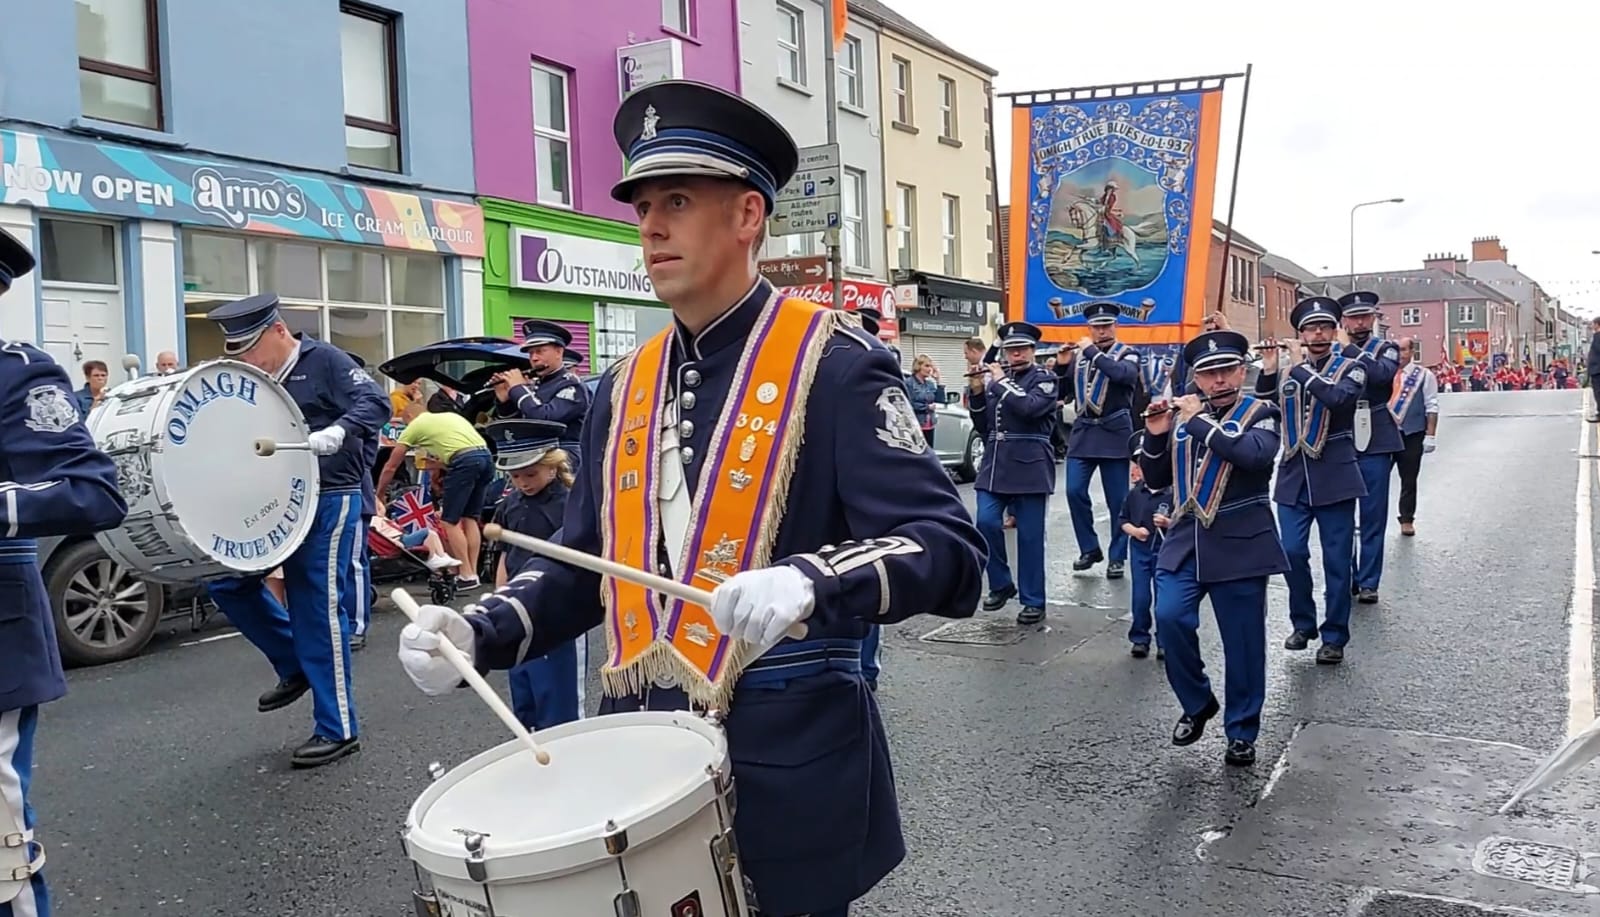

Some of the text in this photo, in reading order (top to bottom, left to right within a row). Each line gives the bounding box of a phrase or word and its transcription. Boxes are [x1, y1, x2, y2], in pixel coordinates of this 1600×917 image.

[1076, 125, 1105, 146] TRUE
[1107, 122, 1138, 141] BLUES
[806, 154, 829, 163] centre
[3, 162, 175, 208] NOW OPEN
[784, 186, 800, 195] Park
[791, 209, 813, 217] routes
[802, 200, 821, 208] other
[320, 207, 474, 244] ICE CREAM PARLOUR
[791, 218, 826, 228] Car Parks
[536, 247, 651, 293] OUTSTANDING
[760, 262, 800, 273] Folk Park
[843, 284, 881, 309] Pops
[1120, 304, 1143, 319] MORY
[168, 372, 259, 445] OMAGH
[736, 412, 778, 437] 304
[212, 533, 269, 560] TRUE
[267, 477, 306, 551] BLUES
[243, 513, 259, 529] Est
